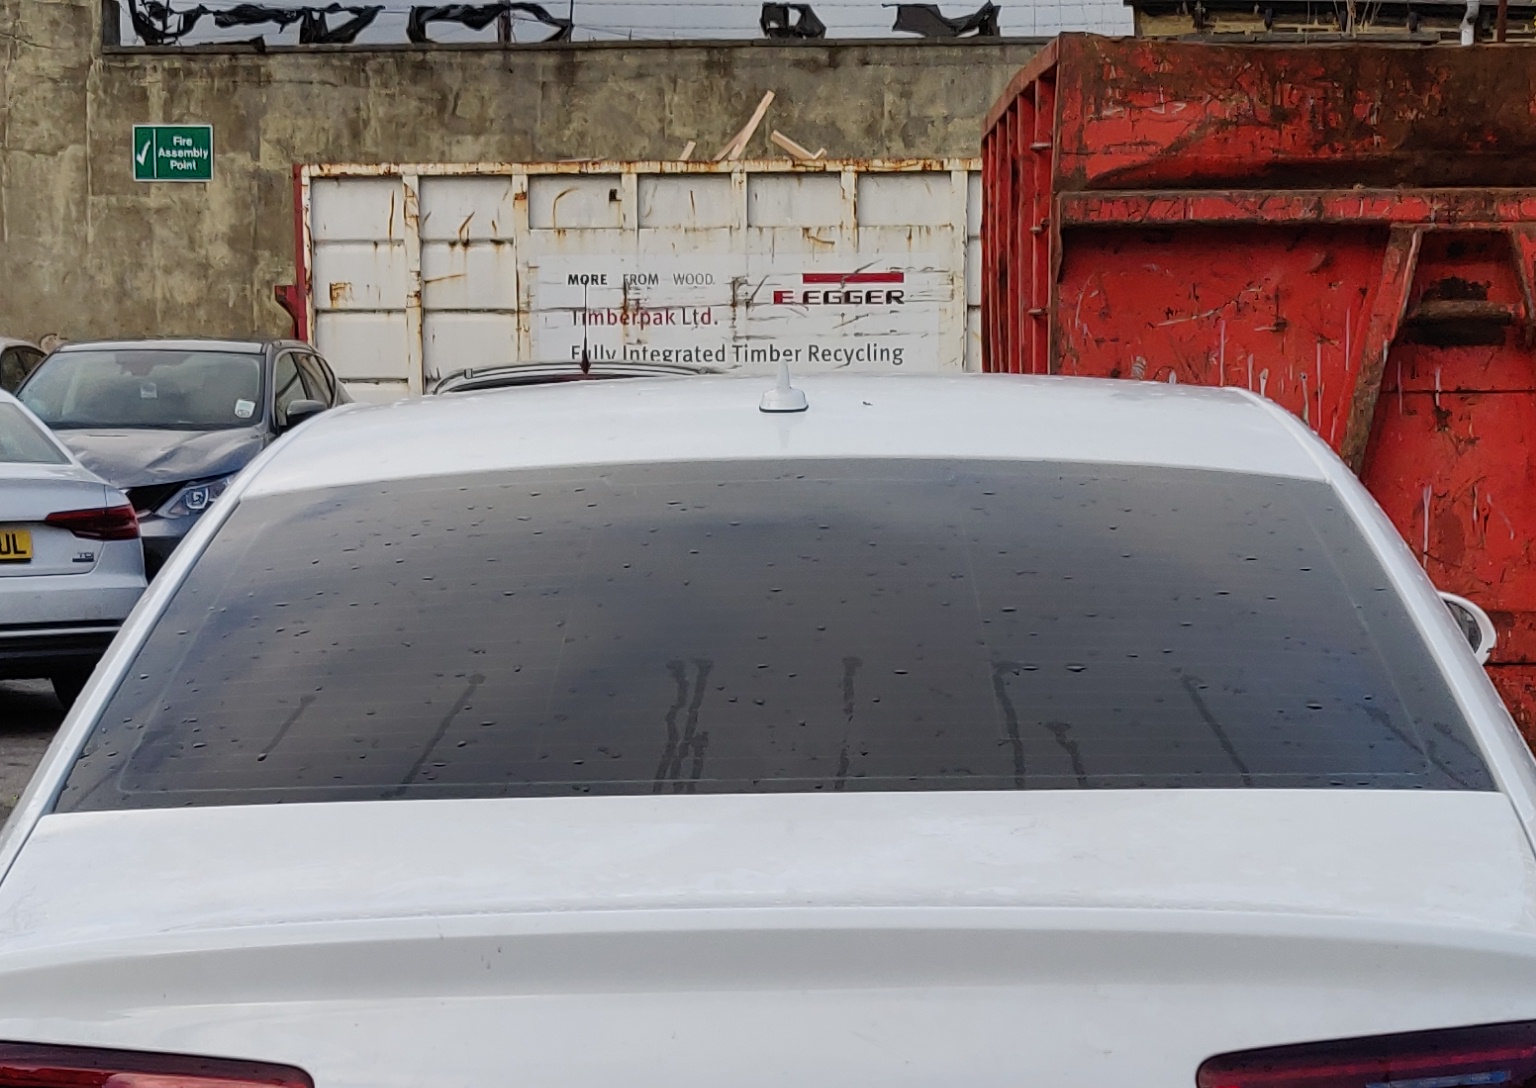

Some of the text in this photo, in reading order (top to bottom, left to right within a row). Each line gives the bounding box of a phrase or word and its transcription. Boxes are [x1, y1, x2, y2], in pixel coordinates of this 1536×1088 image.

[173, 136, 193, 147] Fire
[158, 147, 208, 160] Assembly
[170, 160, 197, 171] Point
[567, 273, 608, 286] MORE
[623, 273, 659, 286] FROM
[802, 289, 905, 305] EGGER
[571, 307, 719, 331] Timberpak Ltd.
[623, 343, 726, 363] Integrated
[732, 344, 802, 363] Timber
[808, 343, 905, 366] Recycling
